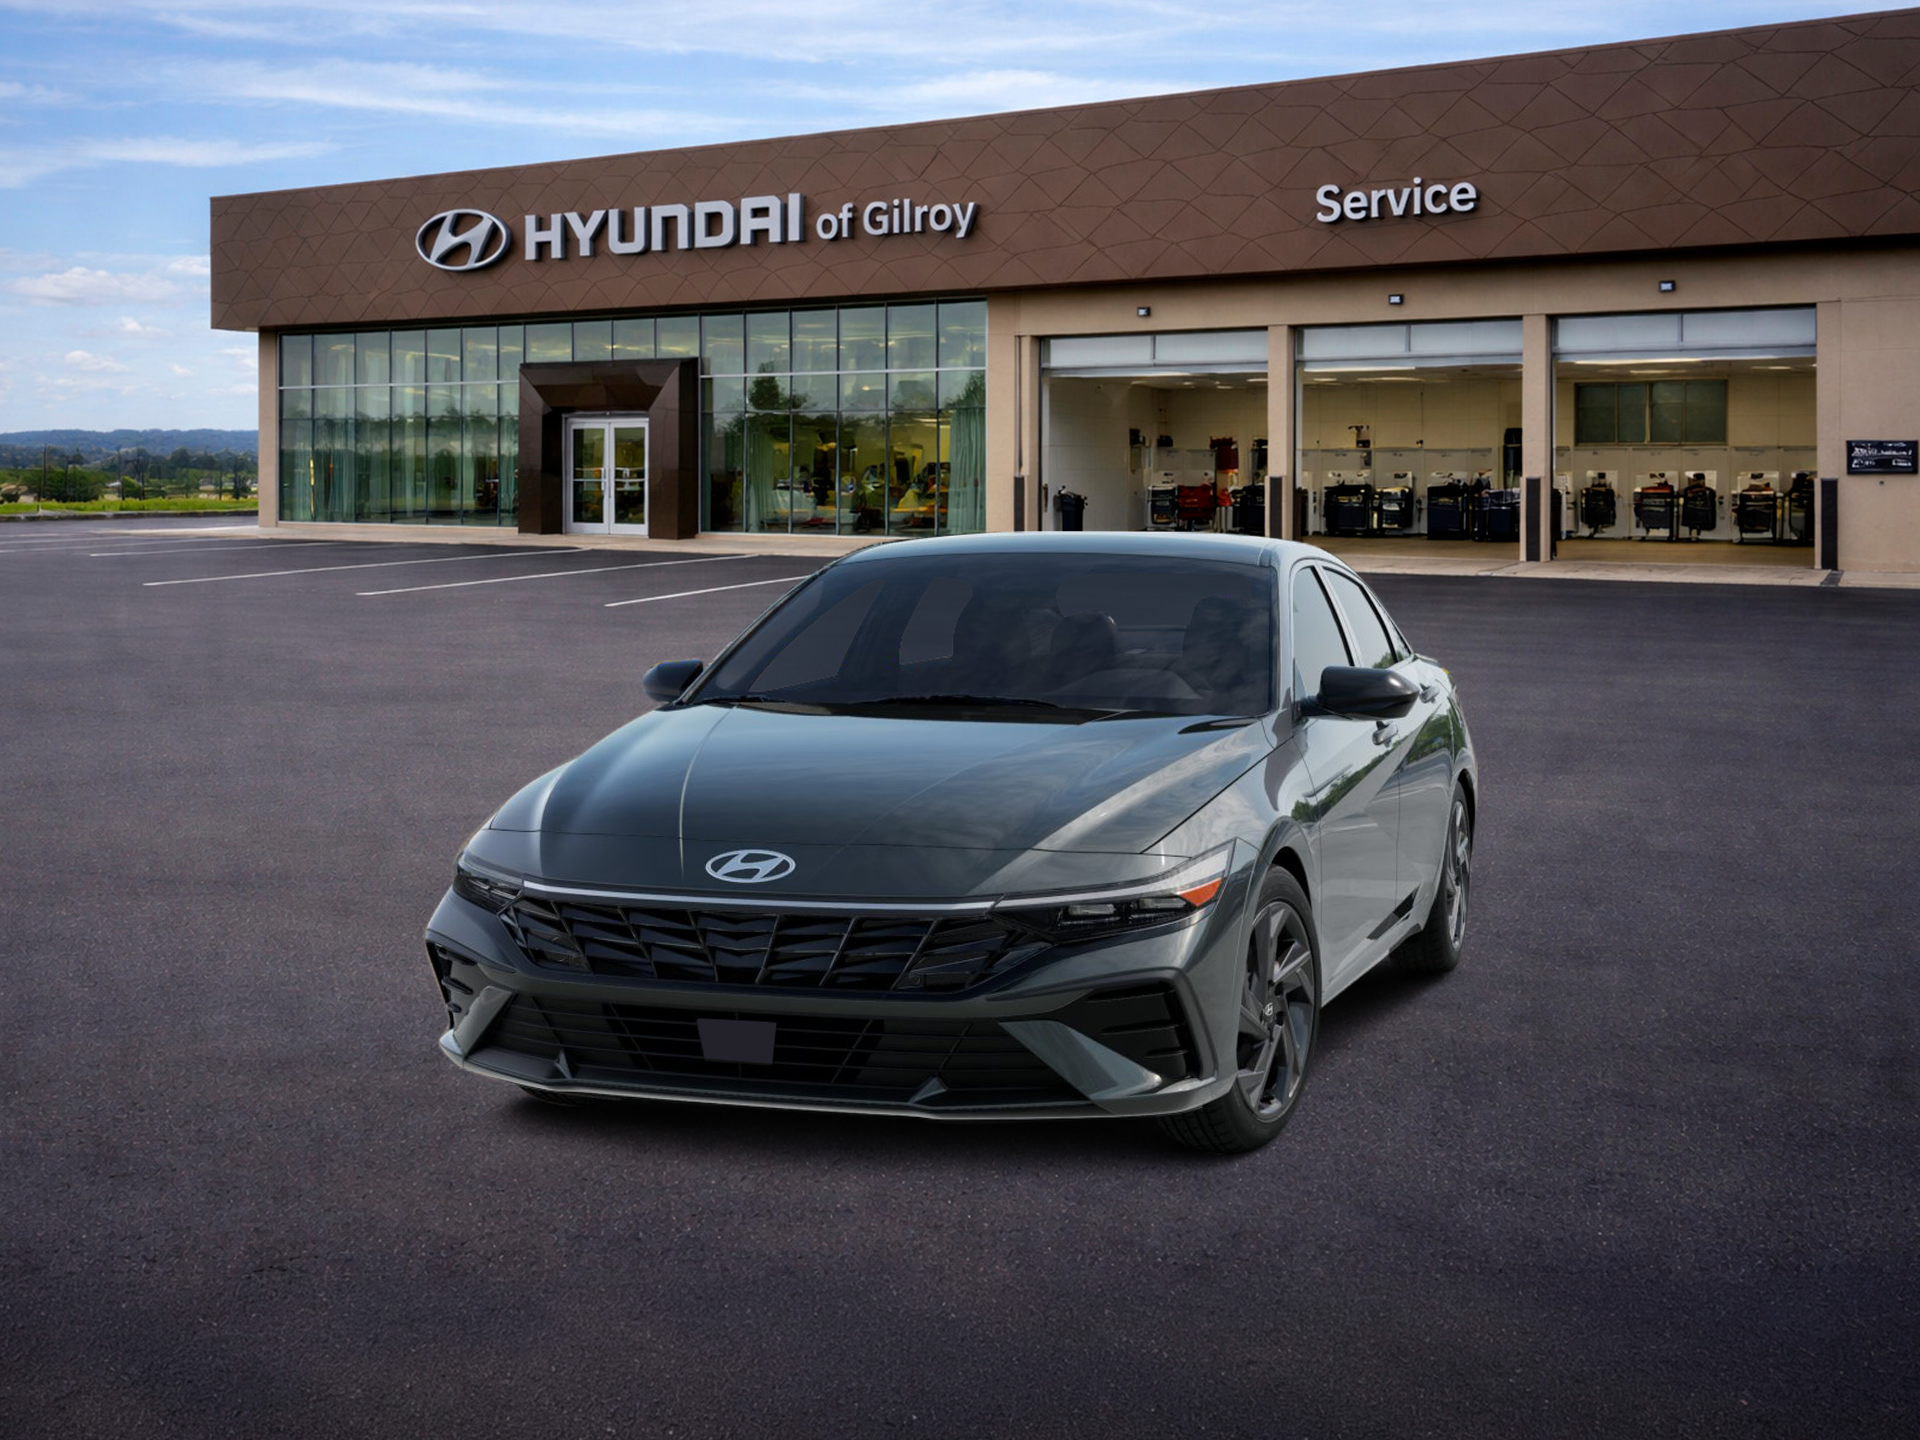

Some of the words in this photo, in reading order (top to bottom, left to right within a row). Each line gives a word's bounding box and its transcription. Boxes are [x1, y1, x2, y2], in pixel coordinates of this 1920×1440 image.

[524, 193, 804, 261] HYUNDAI
[816, 202, 853, 240] of
[863, 198, 976, 238] Gilroy
[1316, 177, 1478, 223] Service
